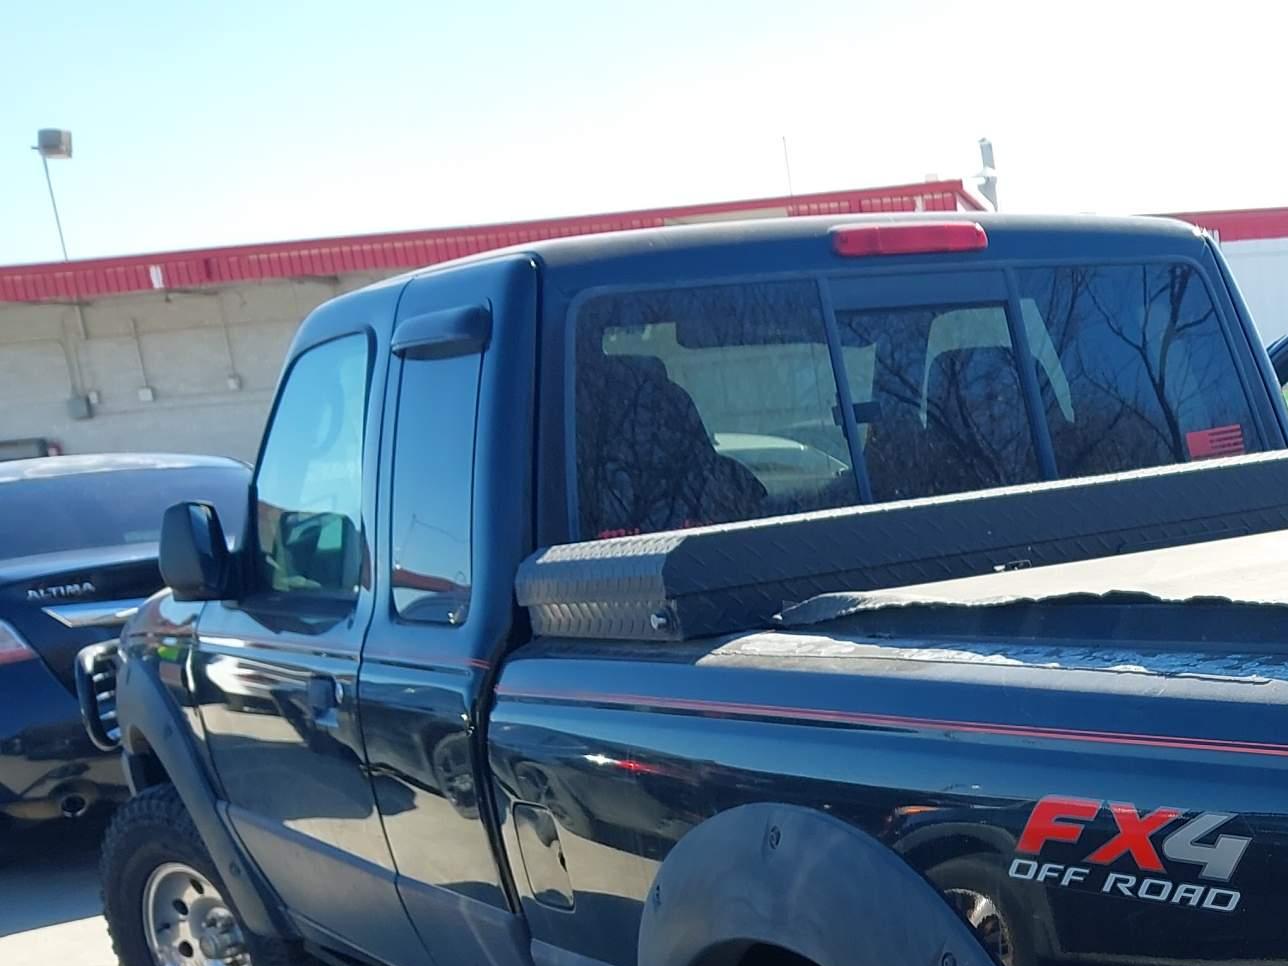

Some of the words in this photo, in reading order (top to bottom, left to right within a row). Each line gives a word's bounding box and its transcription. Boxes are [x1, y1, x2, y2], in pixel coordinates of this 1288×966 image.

[26, 582, 96, 600] ALTIMA
[1014, 794, 1253, 882] FX4
[1008, 858, 1090, 887] OFF
[1102, 872, 1241, 912] ROAD
